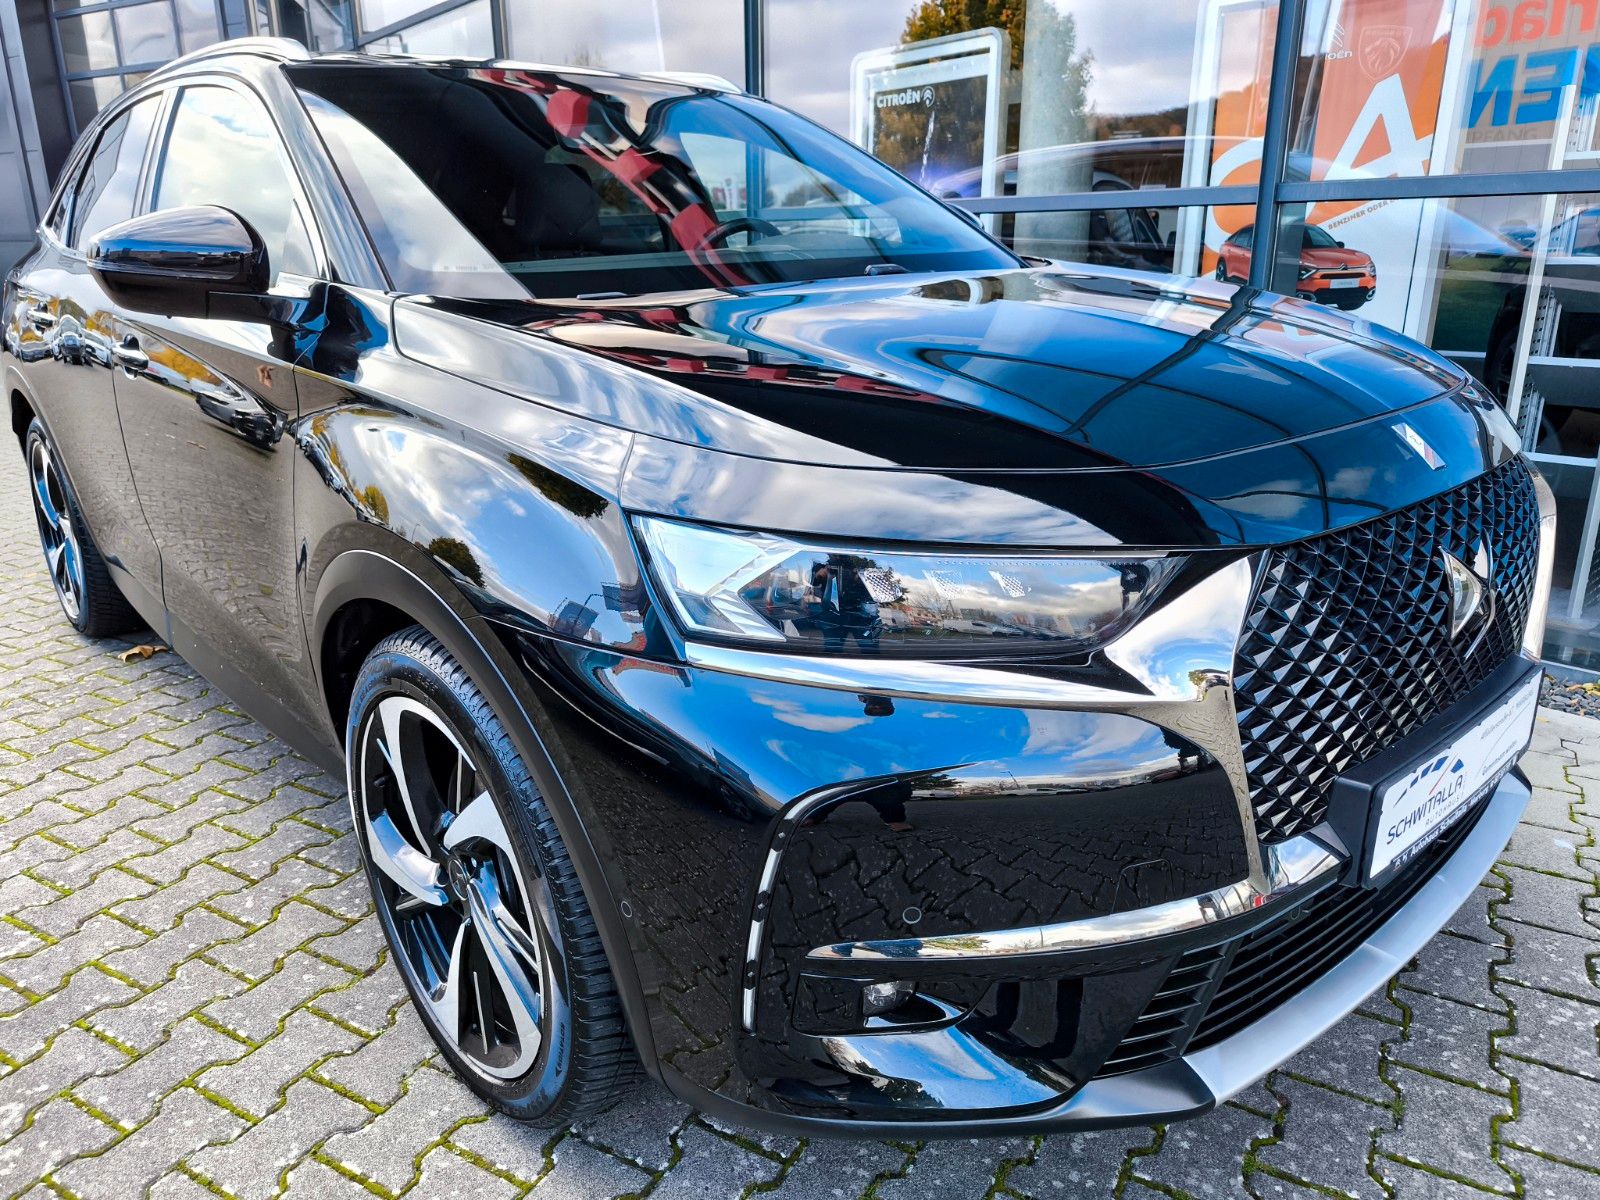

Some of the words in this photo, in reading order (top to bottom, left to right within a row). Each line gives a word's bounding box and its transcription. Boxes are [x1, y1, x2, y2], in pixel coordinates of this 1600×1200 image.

[876, 88, 921, 108] CITROËN
[1327, 209, 1366, 230] BENZINER
[1366, 200, 1389, 213] ODER
[1386, 774, 1464, 845] SCHWITALLA
